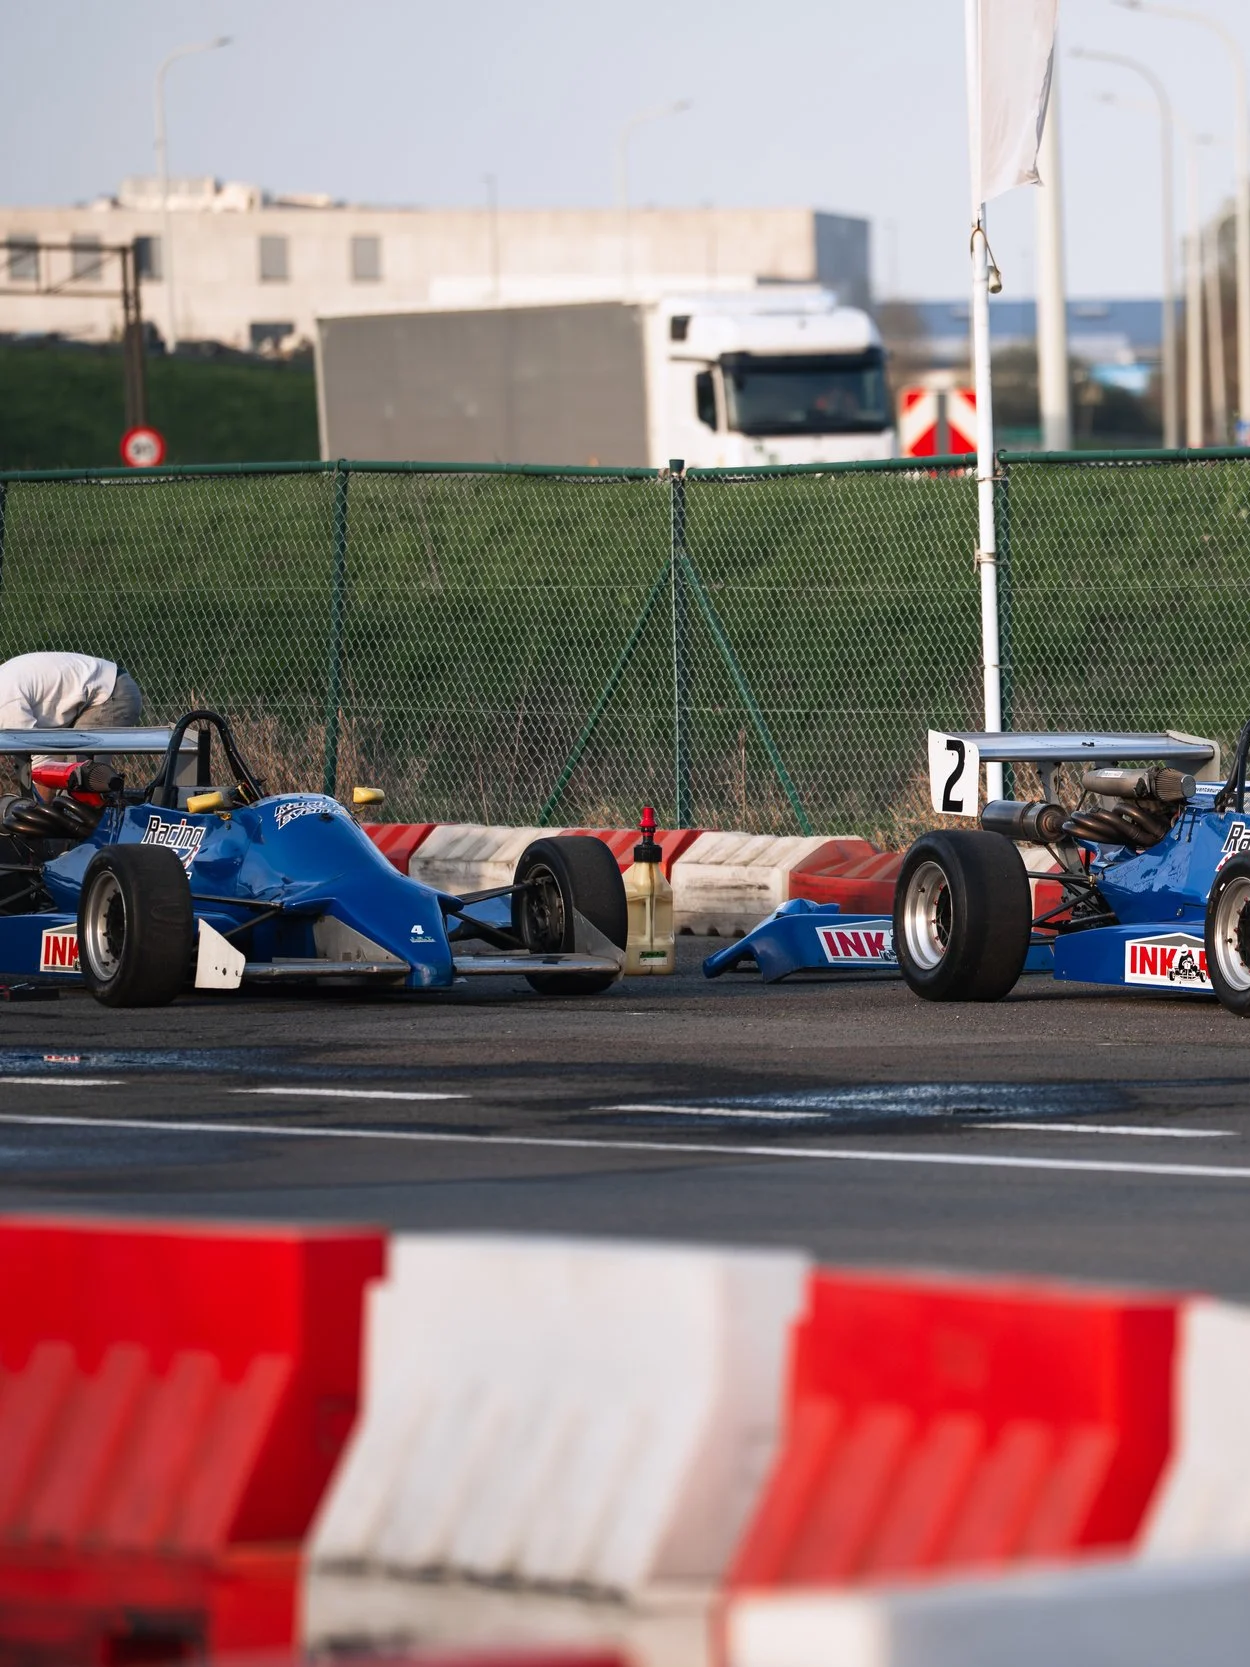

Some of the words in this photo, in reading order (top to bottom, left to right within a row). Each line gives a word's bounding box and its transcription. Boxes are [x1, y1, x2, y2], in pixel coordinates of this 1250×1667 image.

[942, 739, 965, 812] 2
[141, 815, 206, 850] Racing
[411, 925, 424, 935] 4
